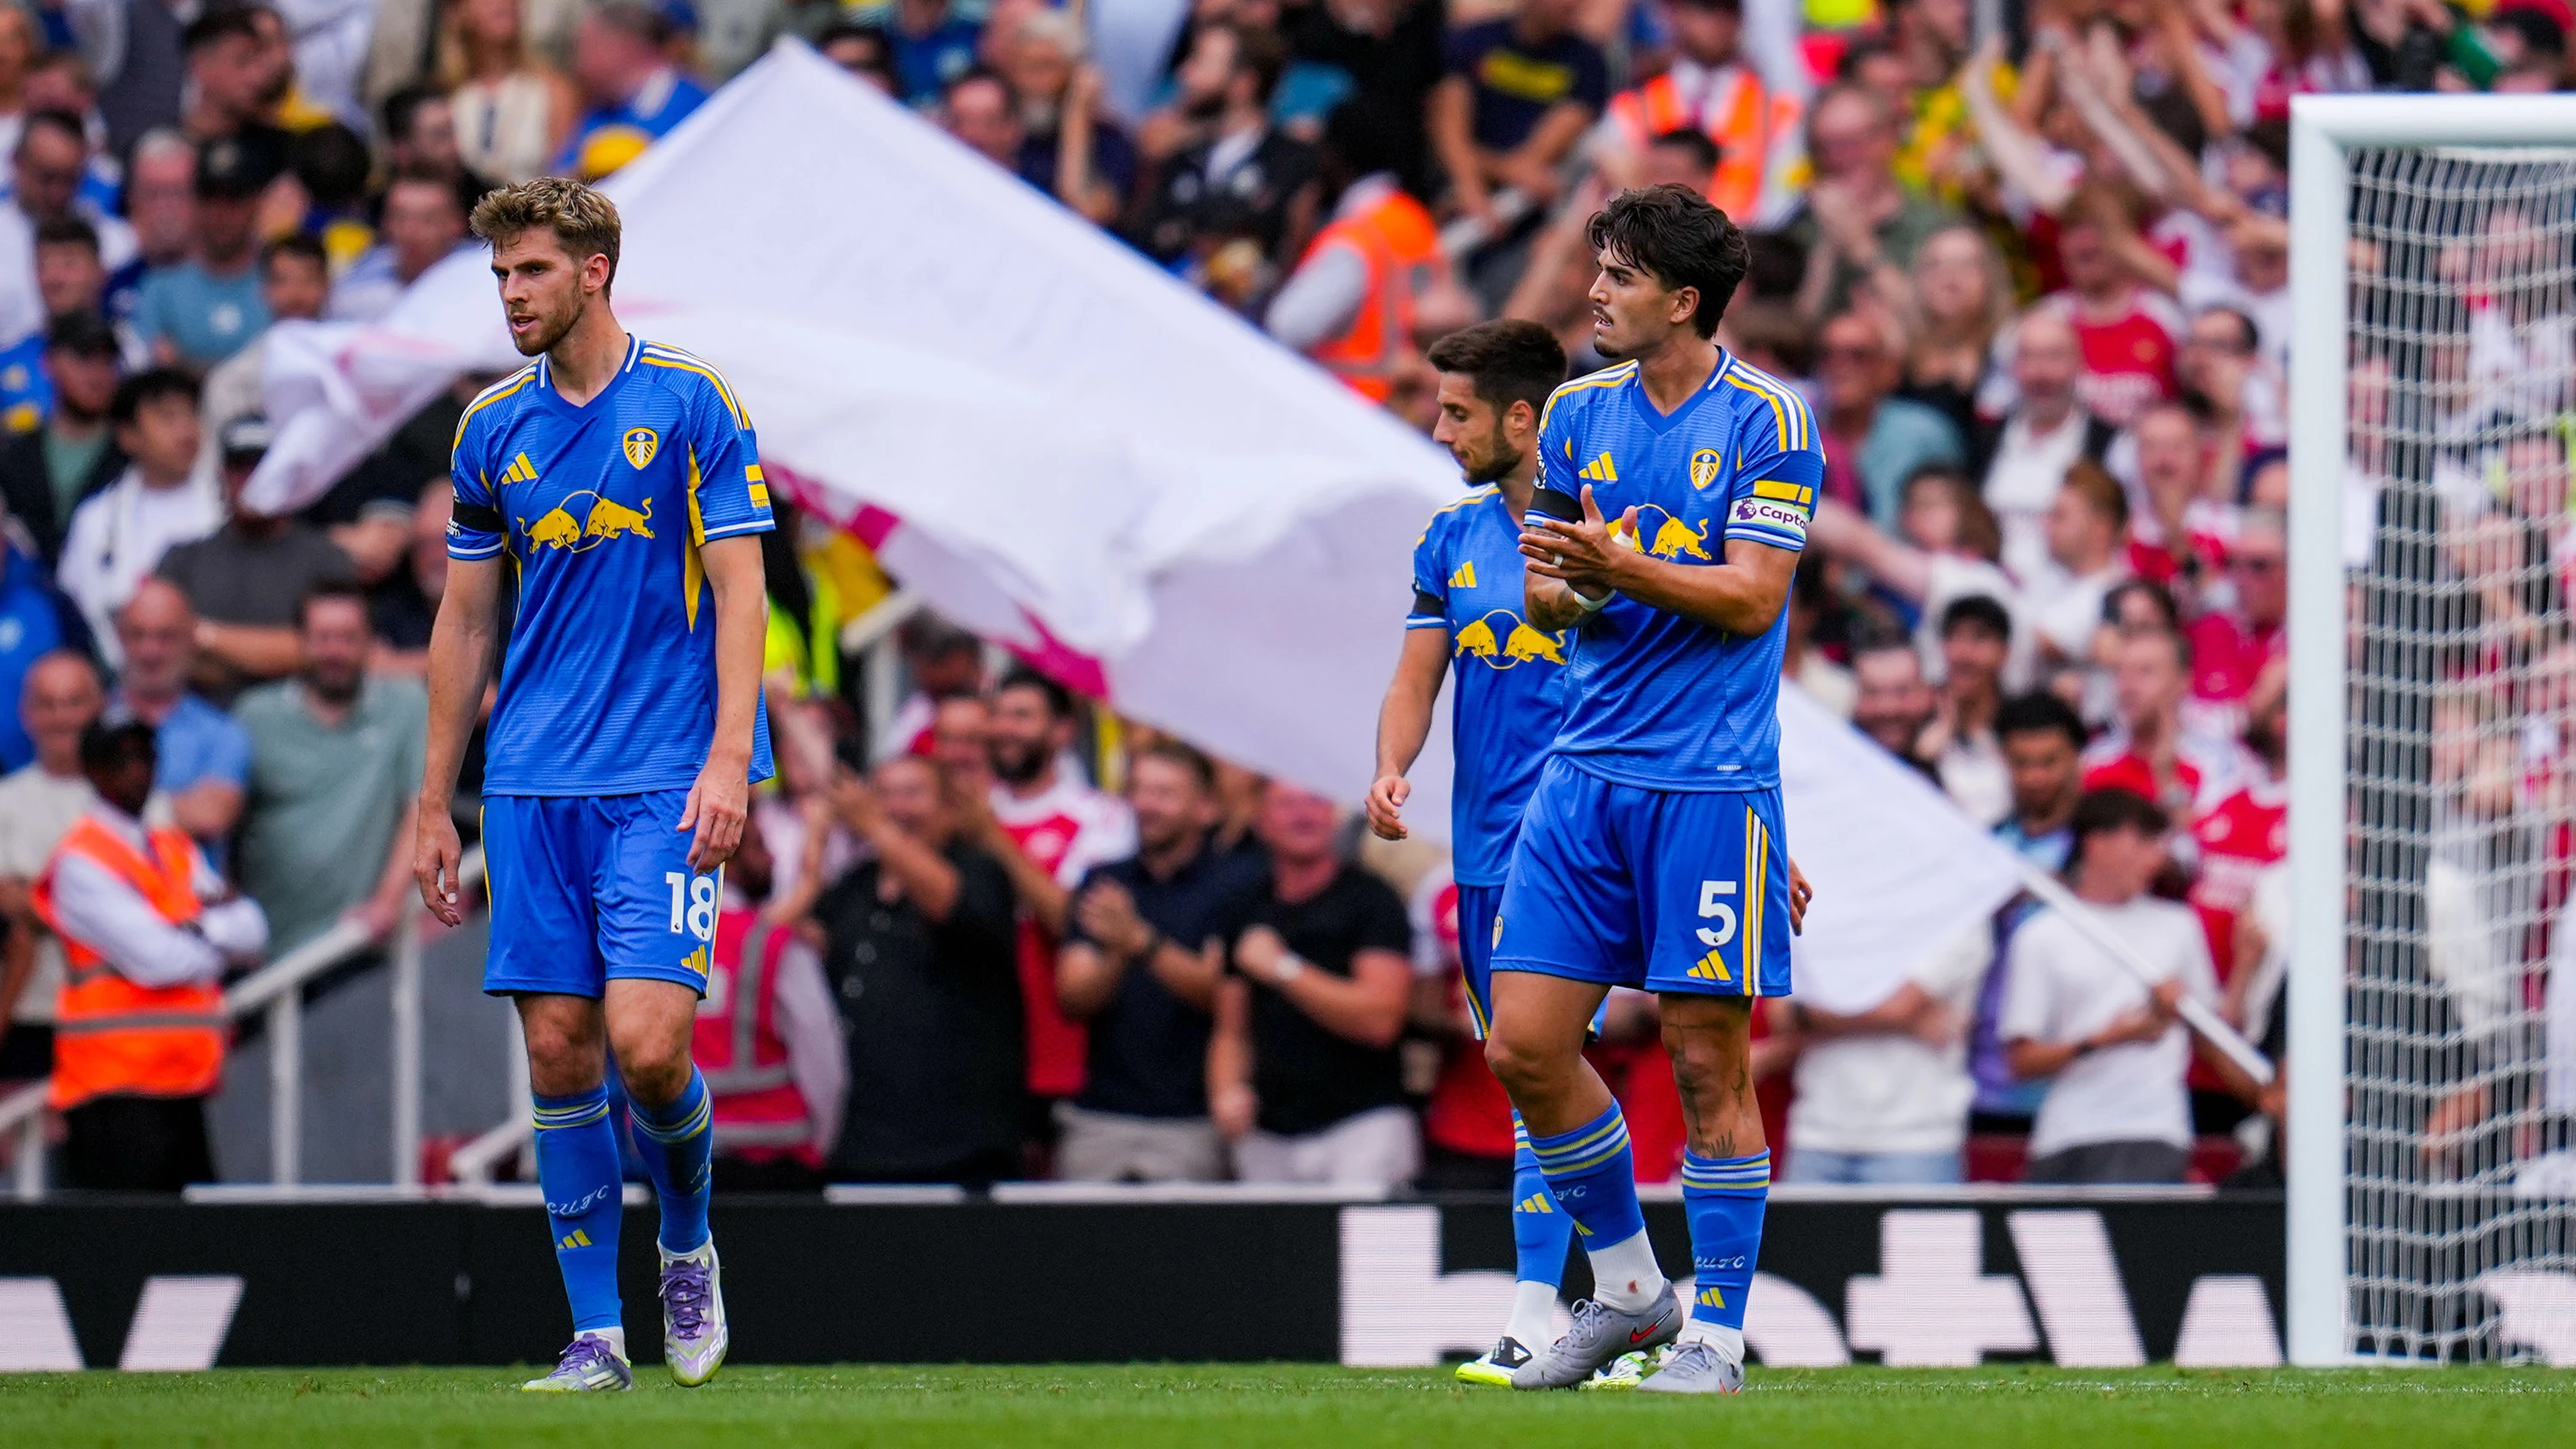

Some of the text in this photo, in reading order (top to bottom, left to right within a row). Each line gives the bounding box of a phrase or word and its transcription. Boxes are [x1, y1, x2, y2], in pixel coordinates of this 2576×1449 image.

[1759, 505, 1808, 529] Capta
[665, 871, 715, 947] 18
[1695, 880, 1737, 947] 5
